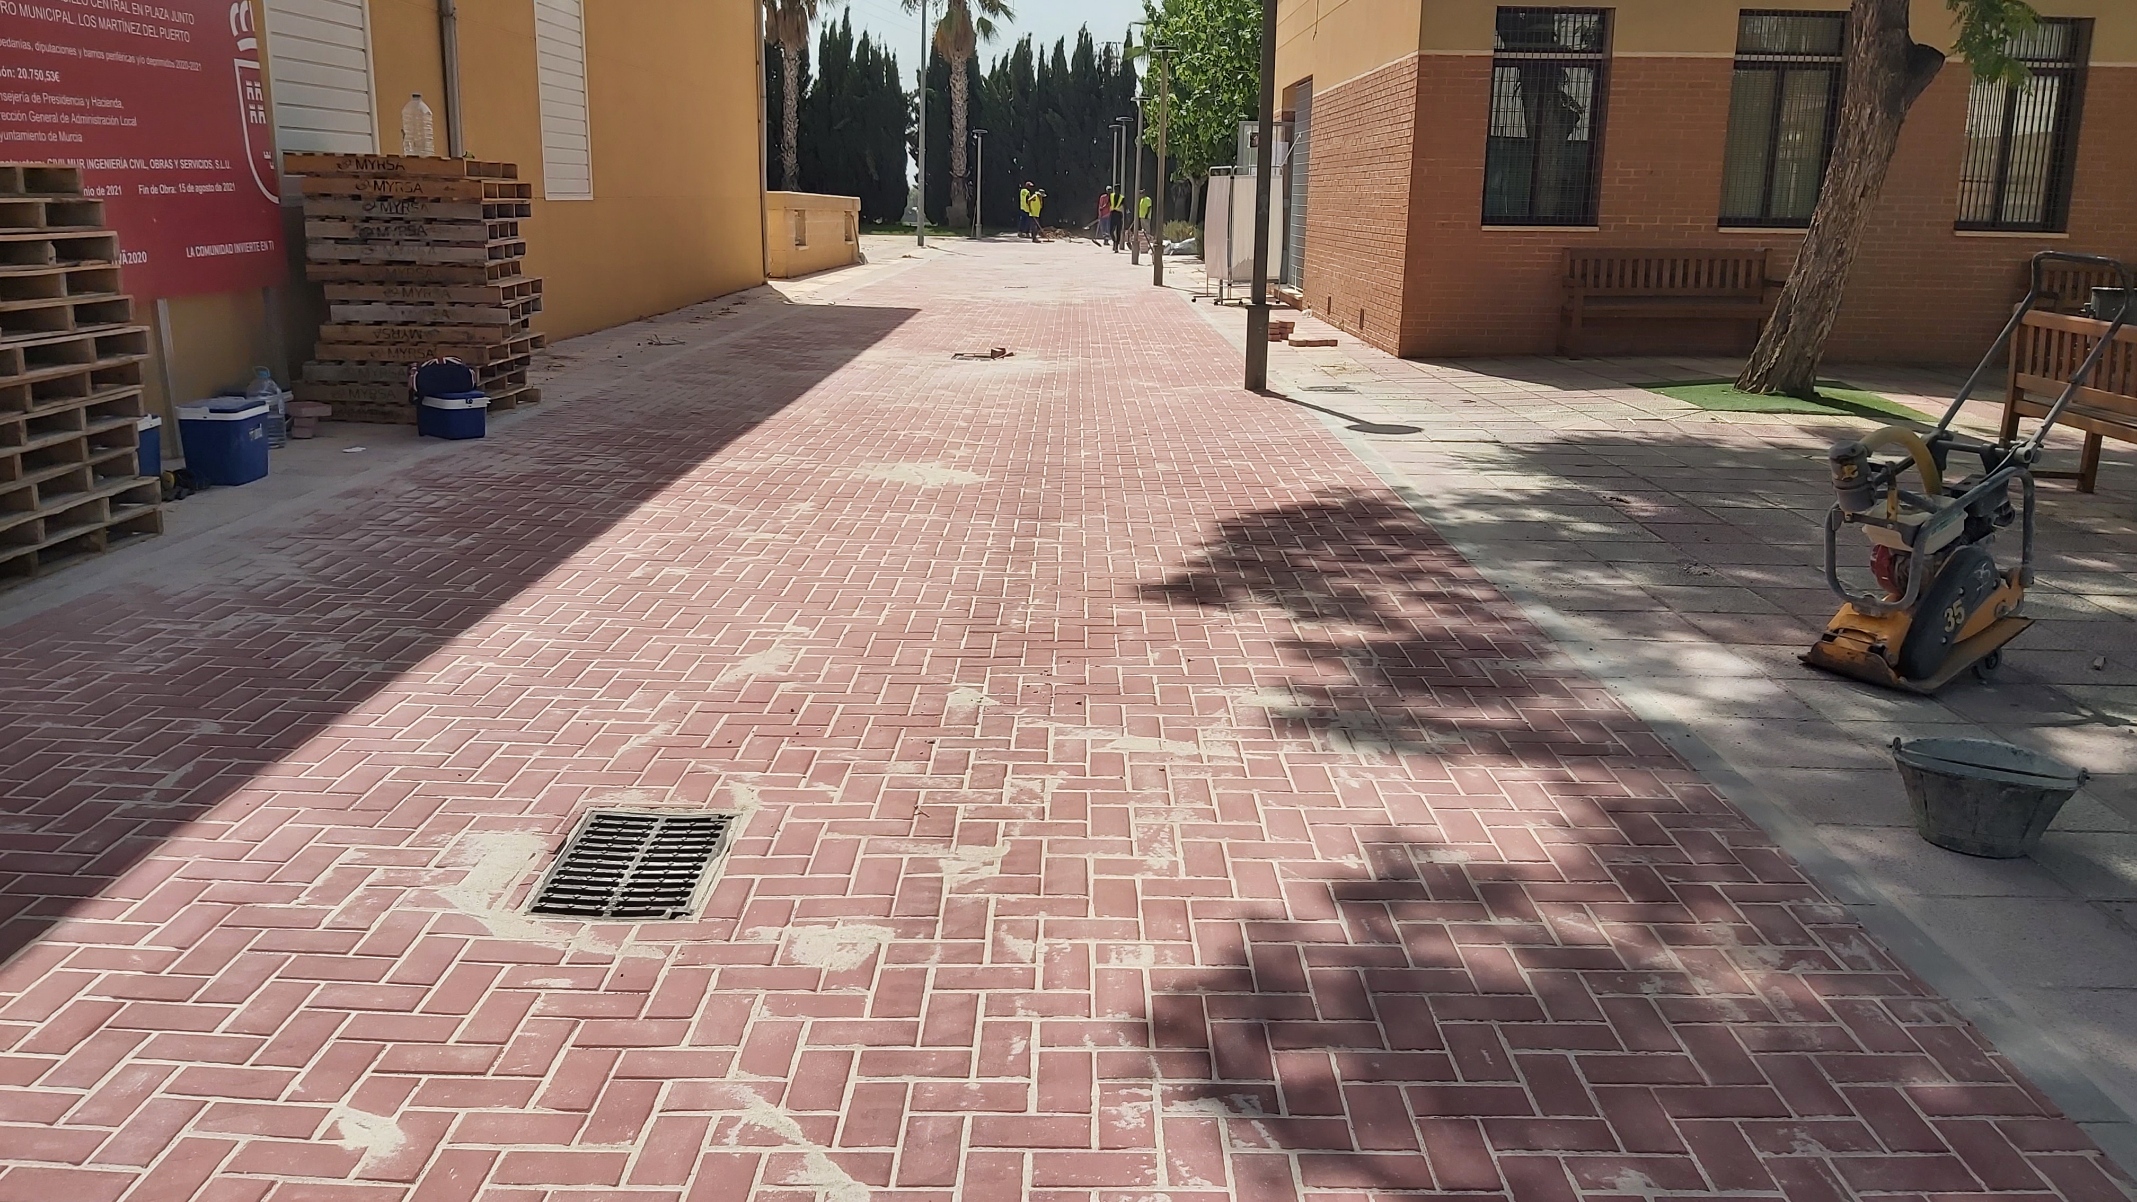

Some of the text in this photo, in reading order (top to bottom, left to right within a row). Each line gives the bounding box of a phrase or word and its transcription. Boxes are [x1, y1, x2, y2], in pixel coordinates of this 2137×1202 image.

[132, 2, 143, 16] EN
[144, 5, 169, 21] PLAZA
[171, 10, 195, 25] JUNTO
[19, 3, 77, 25] MUNICIPAL.
[78, 13, 97, 28] LOS
[98, 16, 142, 36] MARTÍNEZ
[142, 23, 159, 38] DEL
[160, 26, 190, 43] PUERTO
[35, 41, 77, 56] diputaciones
[83, 47, 105, 60] barrios
[17, 67, 60, 82] 20.750,53€
[31, 93, 41, 104] de
[42, 92, 85, 107] Presidencia
[28, 110, 59, 123] General
[60, 112, 69, 123] de
[71, 112, 119, 126] Administración
[120, 115, 137, 126] Local
[48, 131, 57, 142] de
[58, 131, 83, 142] Murcia
[86, 157, 129, 169] INGENIERÍA
[129, 158, 149, 170] CIVIL,
[149, 159, 173, 169] OBRAS
[174, 159, 179, 169] Y
[355, 159, 405, 171] MYRSA
[96, 186, 105, 196] de
[105, 185, 122, 196] 2021
[138, 182, 236, 195] Fin de Obra: 15 de agosto de 2021
[186, 240, 275, 258] LA COMUNIDAD INVIERTE EN TI
[1944, 598, 1965, 633] 35
